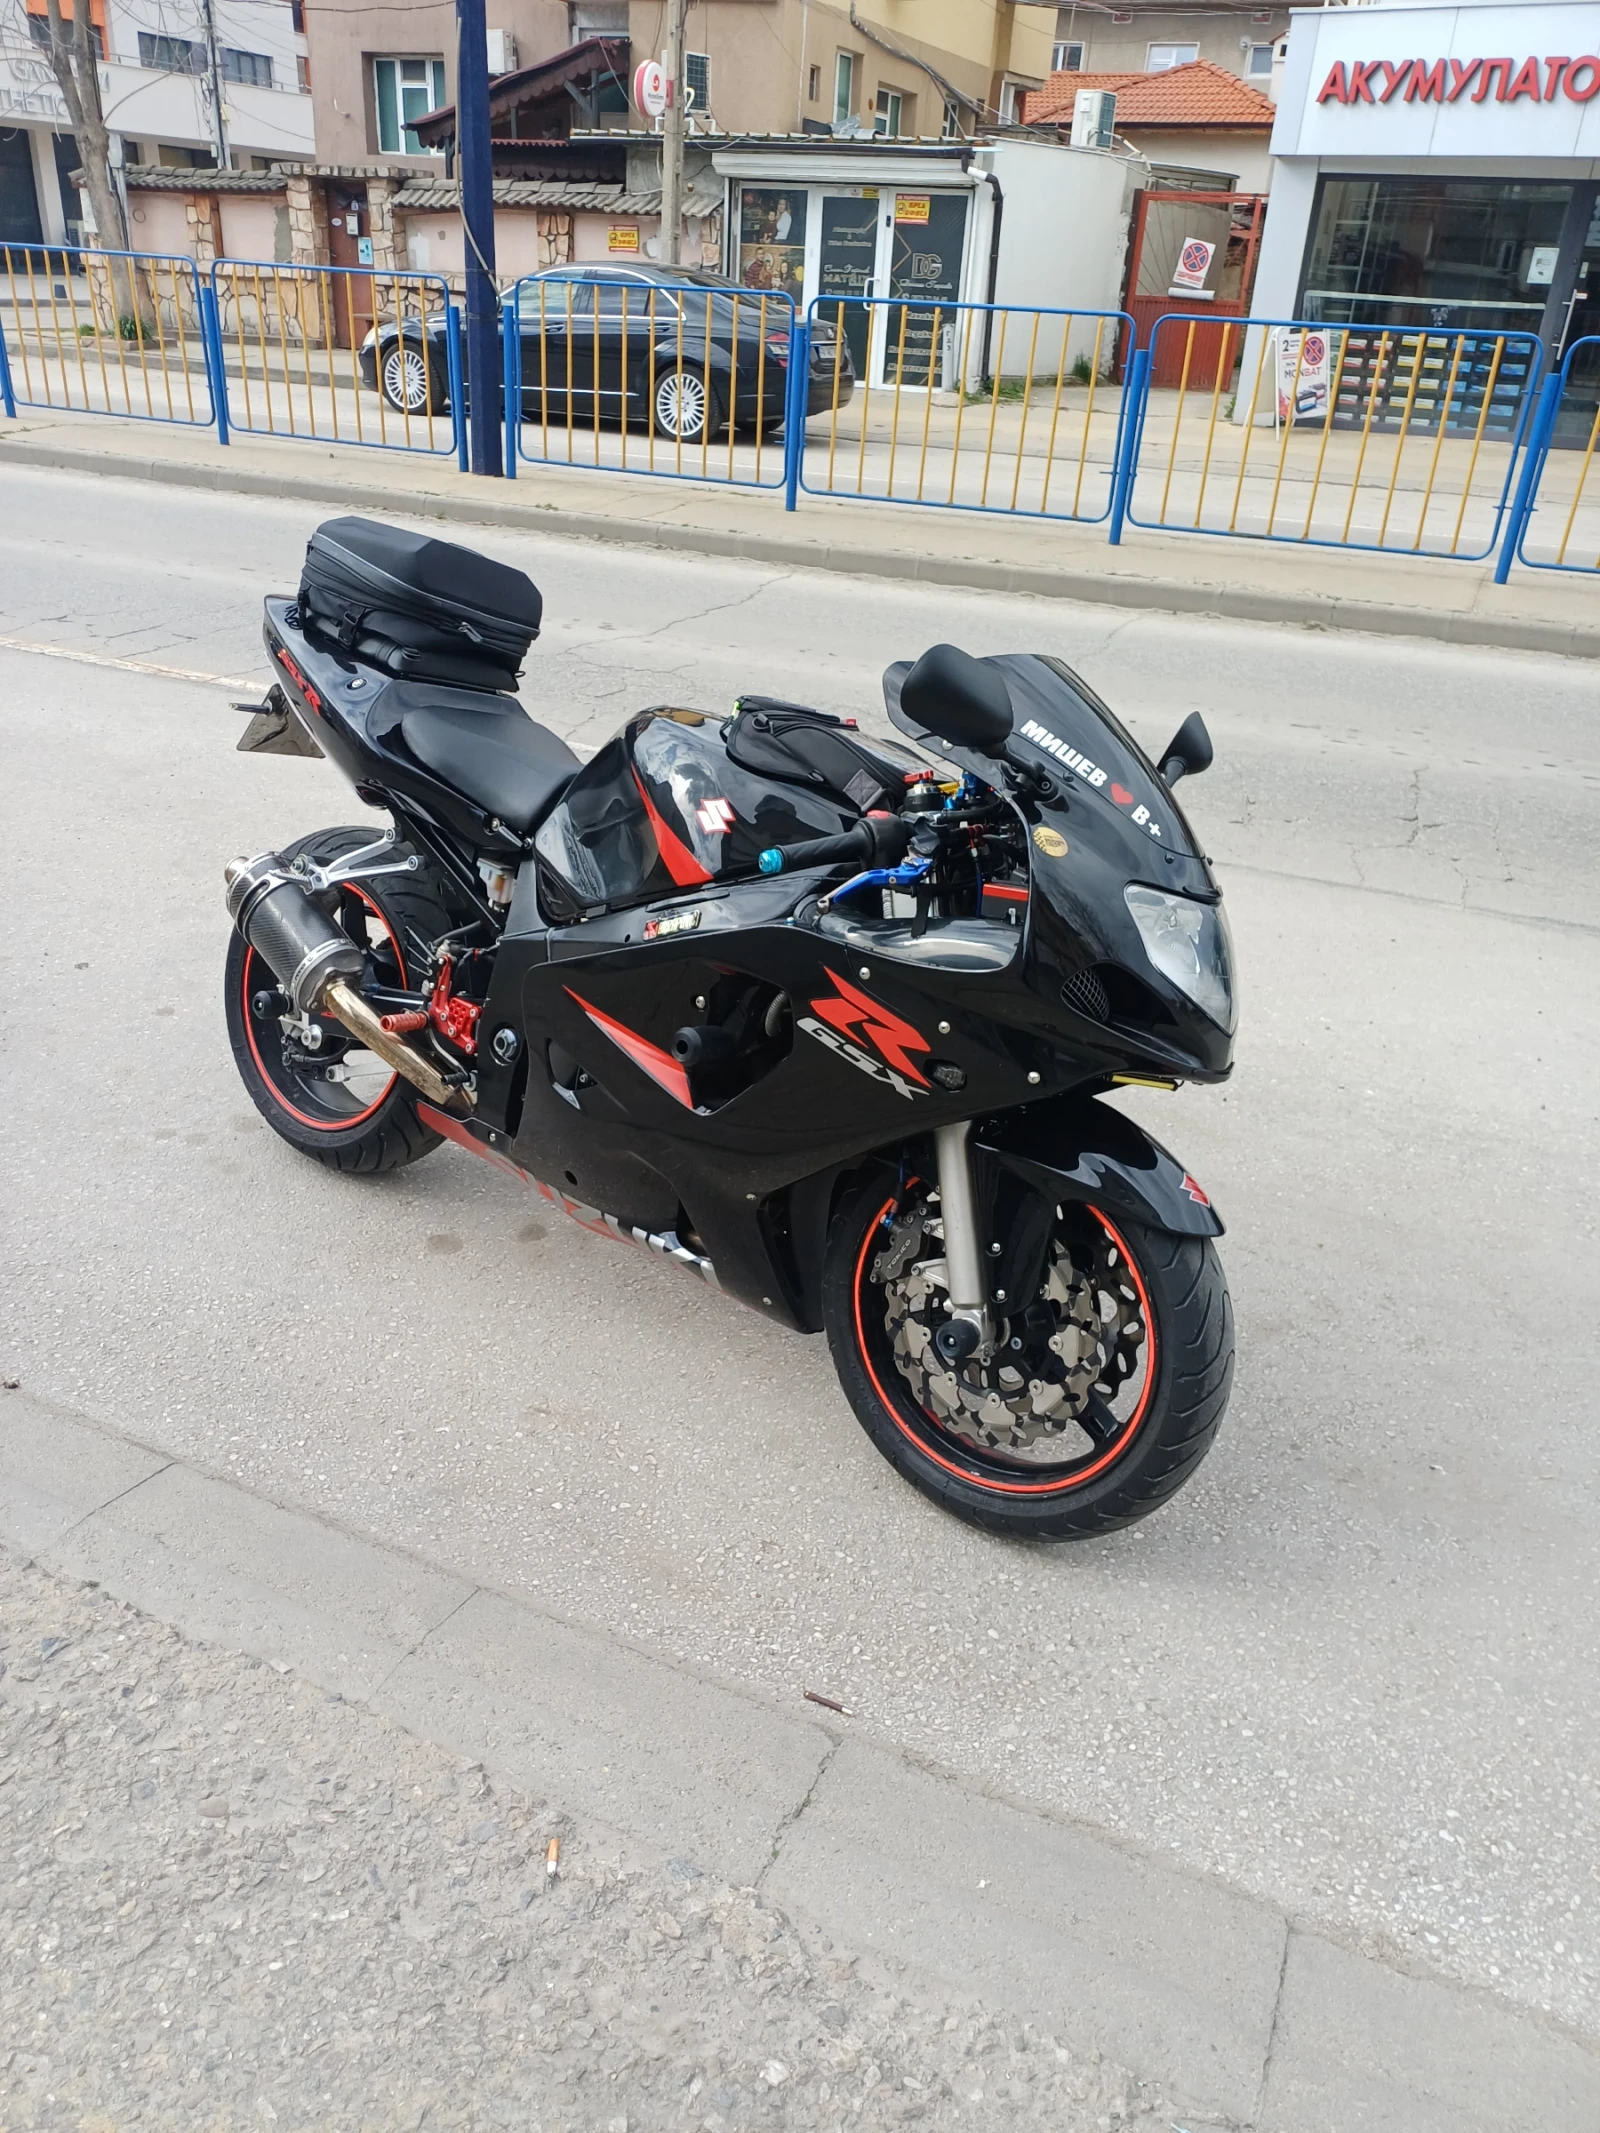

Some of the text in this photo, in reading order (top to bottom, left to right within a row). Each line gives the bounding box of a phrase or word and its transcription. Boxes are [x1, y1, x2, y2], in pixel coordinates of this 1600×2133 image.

[1316, 55, 1600, 104] АКУМУЛАТО
[911, 252, 942, 279] DG
[1282, 339, 1289, 352] 2
[1020, 719, 1108, 787] МИШЕВ
[886, 1238, 911, 1270] TOKICO
